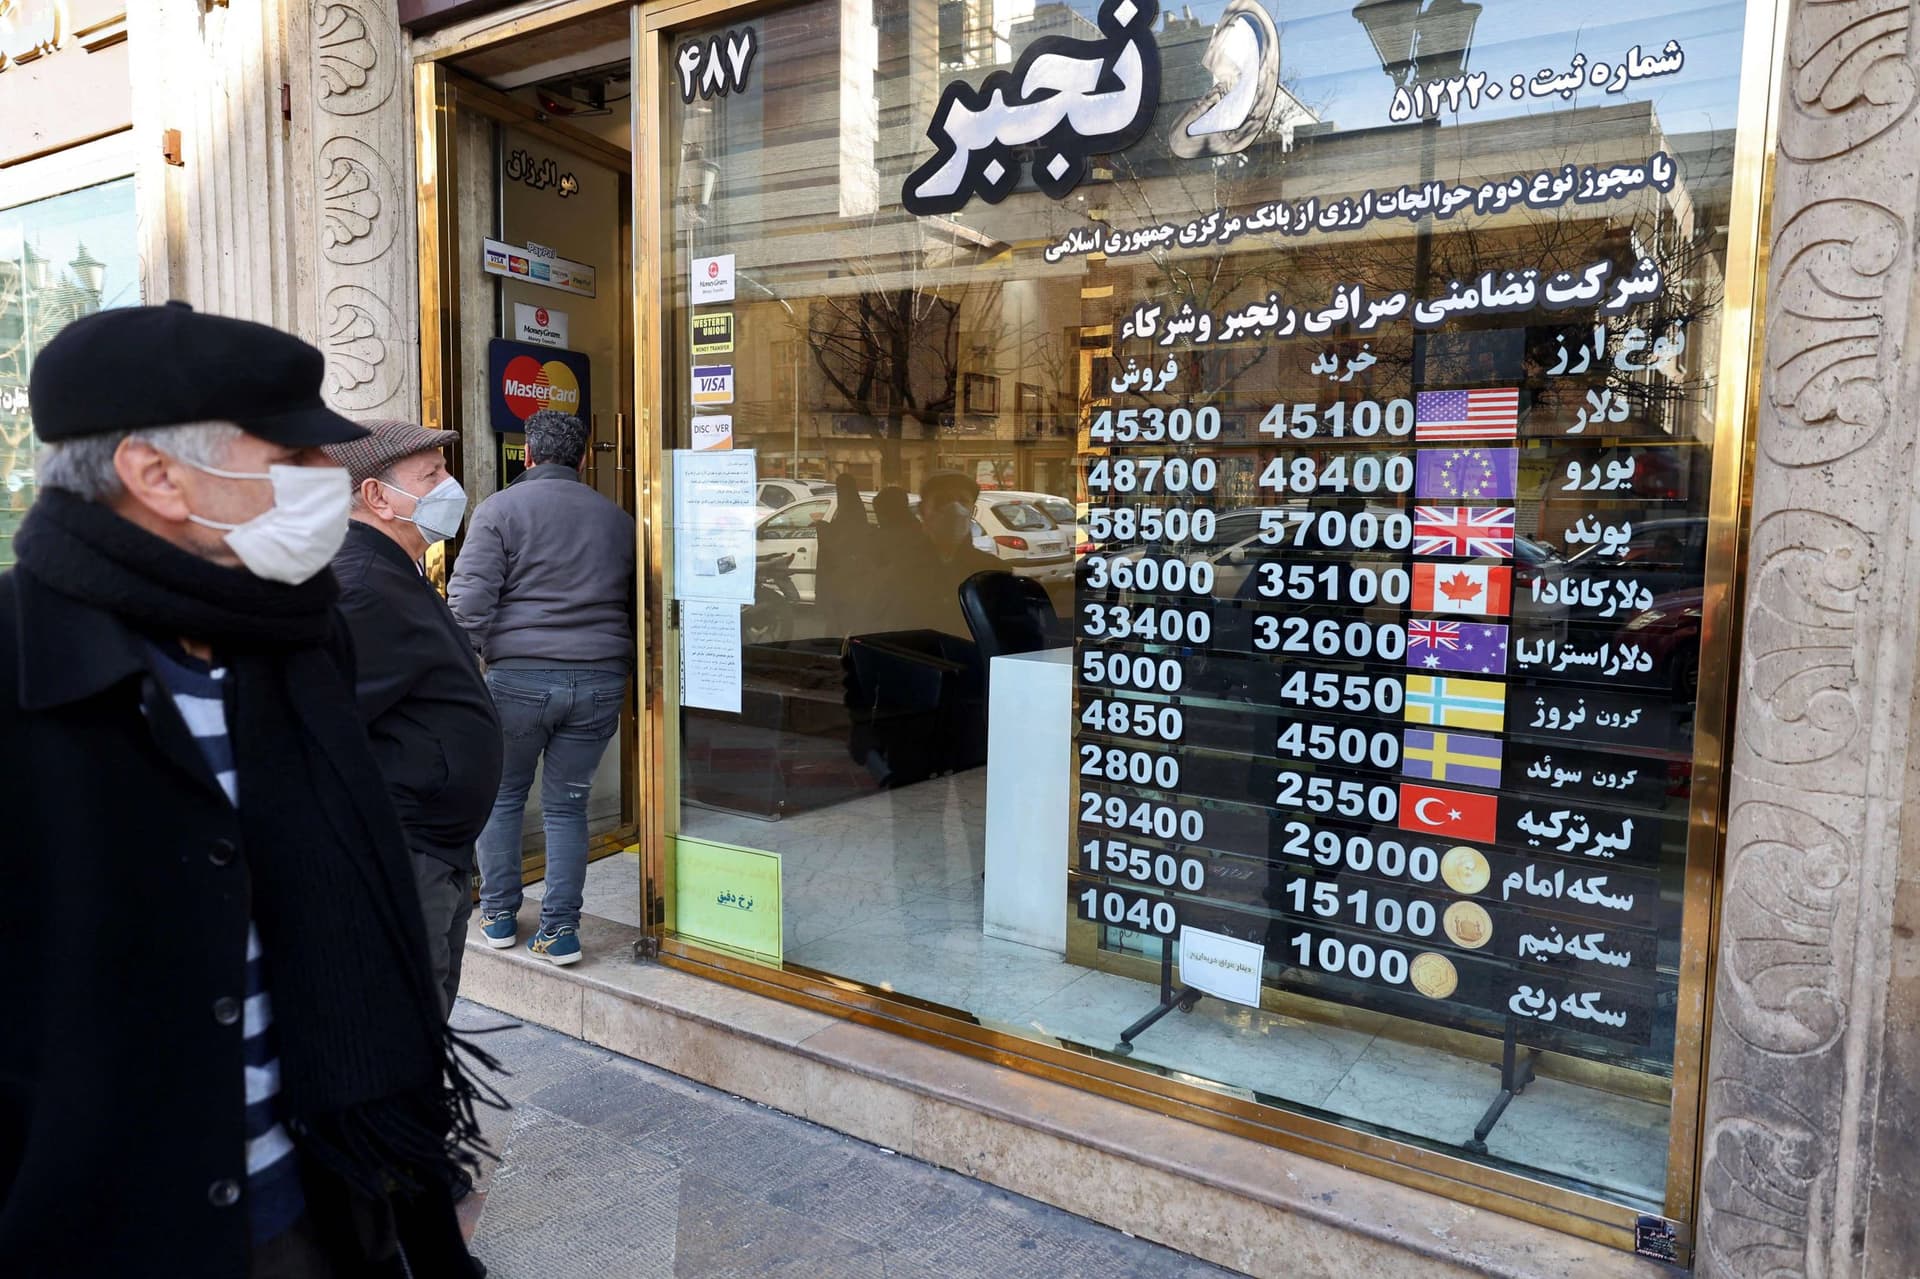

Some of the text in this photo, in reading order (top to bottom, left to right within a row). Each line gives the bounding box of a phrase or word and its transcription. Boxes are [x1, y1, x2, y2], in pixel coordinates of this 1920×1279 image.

[677, 29, 756, 102] ۴۸۷
[1590, 40, 1684, 94] شماره
[1389, 71, 1503, 122] ۵۱۲۲۲۰
[507, 150, 557, 189] الرزاق
[1045, 154, 1673, 261] با مجوز نوع دوم حوالجات ارزی از بانک مرکزی جمهوری اسلامی
[490, 255, 504, 265] VISA
[1414, 269, 1538, 323] تضامنی
[1545, 257, 1660, 309] شرکت
[693, 317, 727, 328] WESTERN
[1217, 294, 1297, 341] رنجبر
[1303, 285, 1407, 333] صرافی
[523, 324, 561, 339] MoneyGram
[703, 326, 727, 336] UNION
[1546, 317, 1686, 375] نوع ارز
[1110, 353, 1178, 393] فروش
[1311, 342, 1378, 382] خرید
[504, 379, 577, 403] MasterCard
[700, 377, 726, 392] VISA
[1090, 406, 1221, 442] 45300
[1259, 398, 1414, 439] 45100
[1566, 388, 1630, 433] دلار
[1088, 457, 1217, 492] 48700
[1259, 456, 1414, 493] 48400
[1561, 456, 1636, 490] یورو
[1089, 507, 1217, 543] 58500
[1258, 509, 1412, 550] 57000
[1565, 514, 1632, 556] پوند
[1086, 557, 1214, 594] 36000
[1257, 562, 1410, 604] 35100
[1083, 604, 1211, 644] 33400
[1253, 615, 1406, 661] 32600
[1083, 651, 1182, 692] 5000
[1280, 671, 1403, 714] 4550
[1081, 700, 1183, 740] 4850
[1529, 697, 1642, 730] کرون نروژ
[1277, 723, 1399, 768] 4500
[1080, 744, 1179, 789] 2800
[1527, 755, 1638, 789] کرون سوئد
[1080, 792, 1204, 842] 29400
[1276, 771, 1397, 822] 2550
[1083, 839, 1205, 891] 15500
[1282, 822, 1439, 883] 29000
[717, 890, 753, 909] نرخ دقیق
[1081, 888, 1176, 934] 1040
[1286, 878, 1436, 937] 15100
[1291, 932, 1408, 985] 1000
